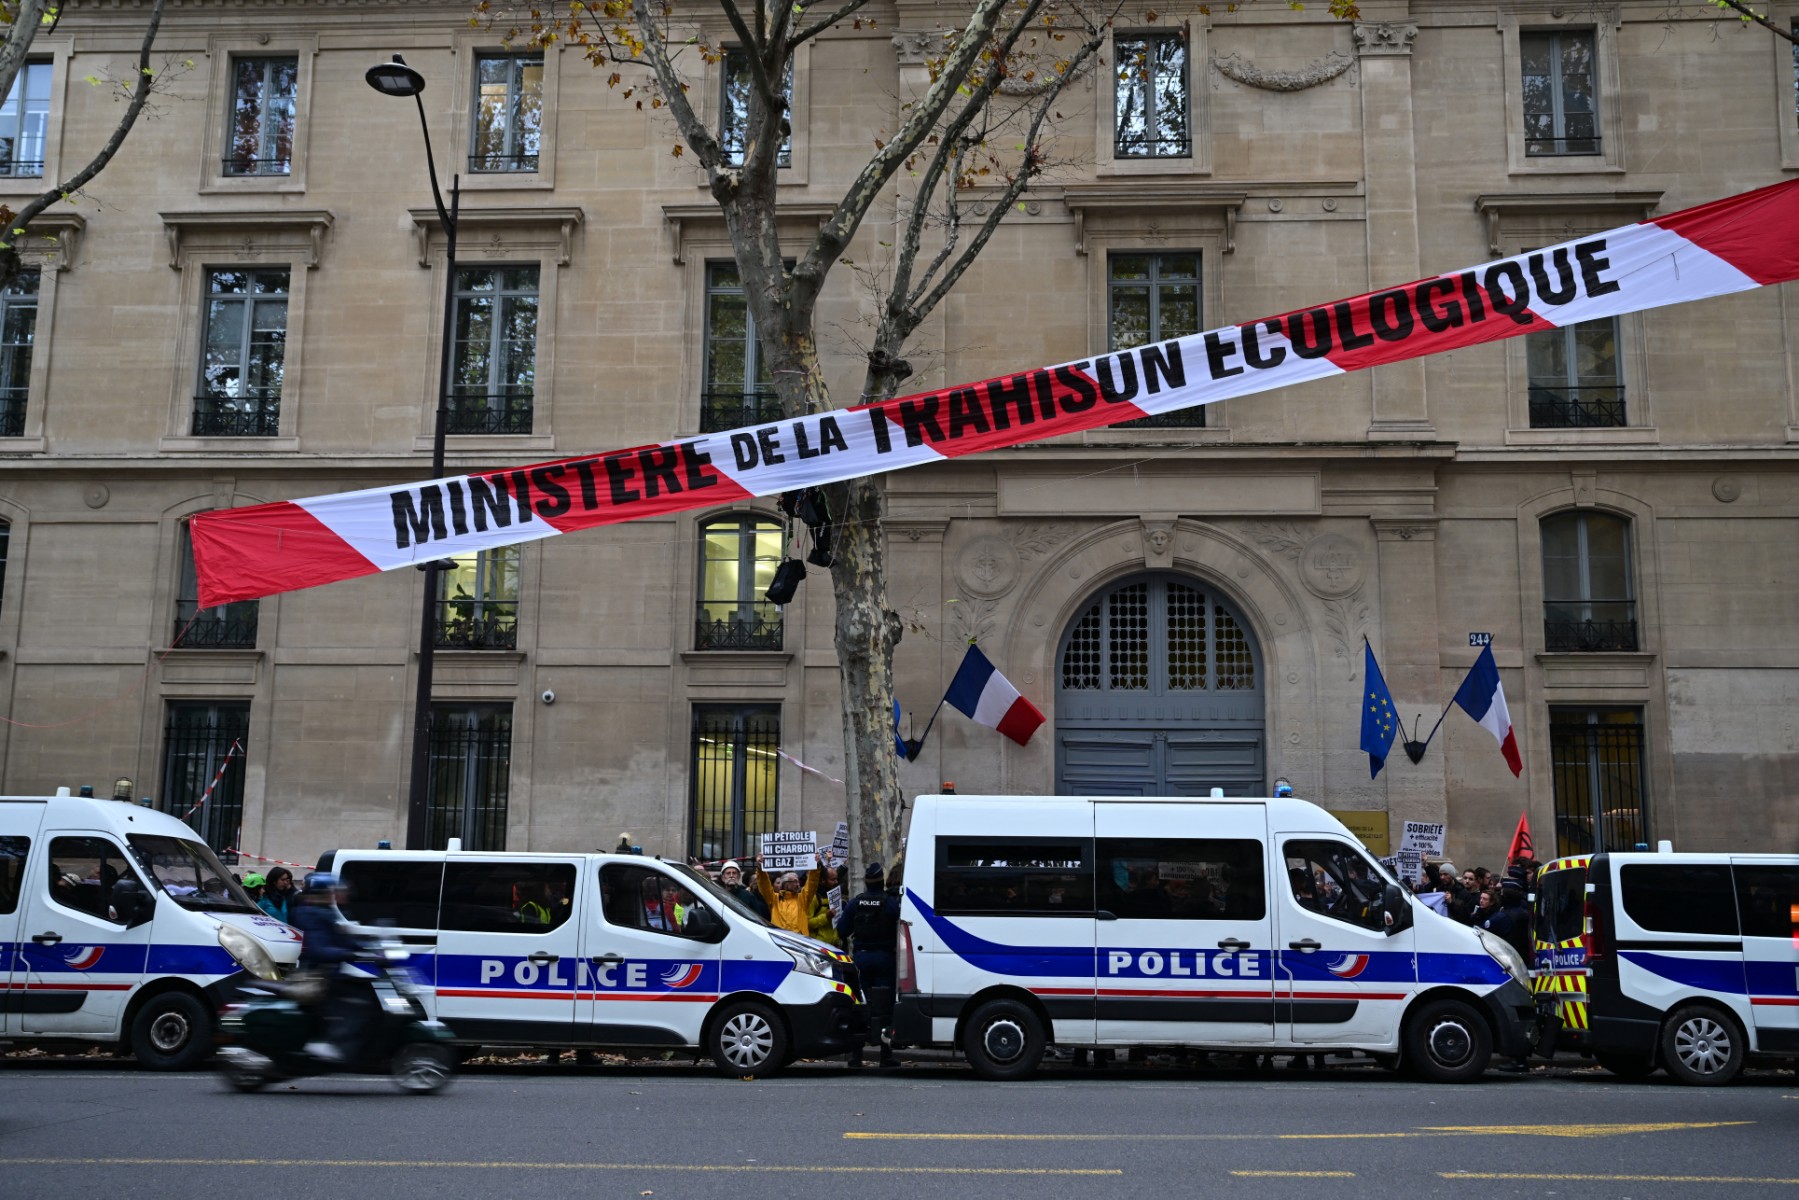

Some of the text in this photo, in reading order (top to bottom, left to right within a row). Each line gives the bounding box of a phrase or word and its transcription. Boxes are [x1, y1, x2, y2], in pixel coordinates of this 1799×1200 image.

[730, 426, 786, 472] DE
[792, 415, 849, 460] LA
[1470, 633, 1490, 646] 244
[1407, 823, 1444, 835] SOBRIÉTÉ
[764, 831, 810, 842] NI PÉTROLE
[764, 845, 773, 854] NI
[774, 844, 815, 855] CHARBON
[764, 858, 773, 867] NI
[775, 857, 792, 867] GAZ
[1108, 951, 1260, 977] POLICE
[1554, 954, 1580, 966] POLICE
[480, 959, 648, 988] POLICE
